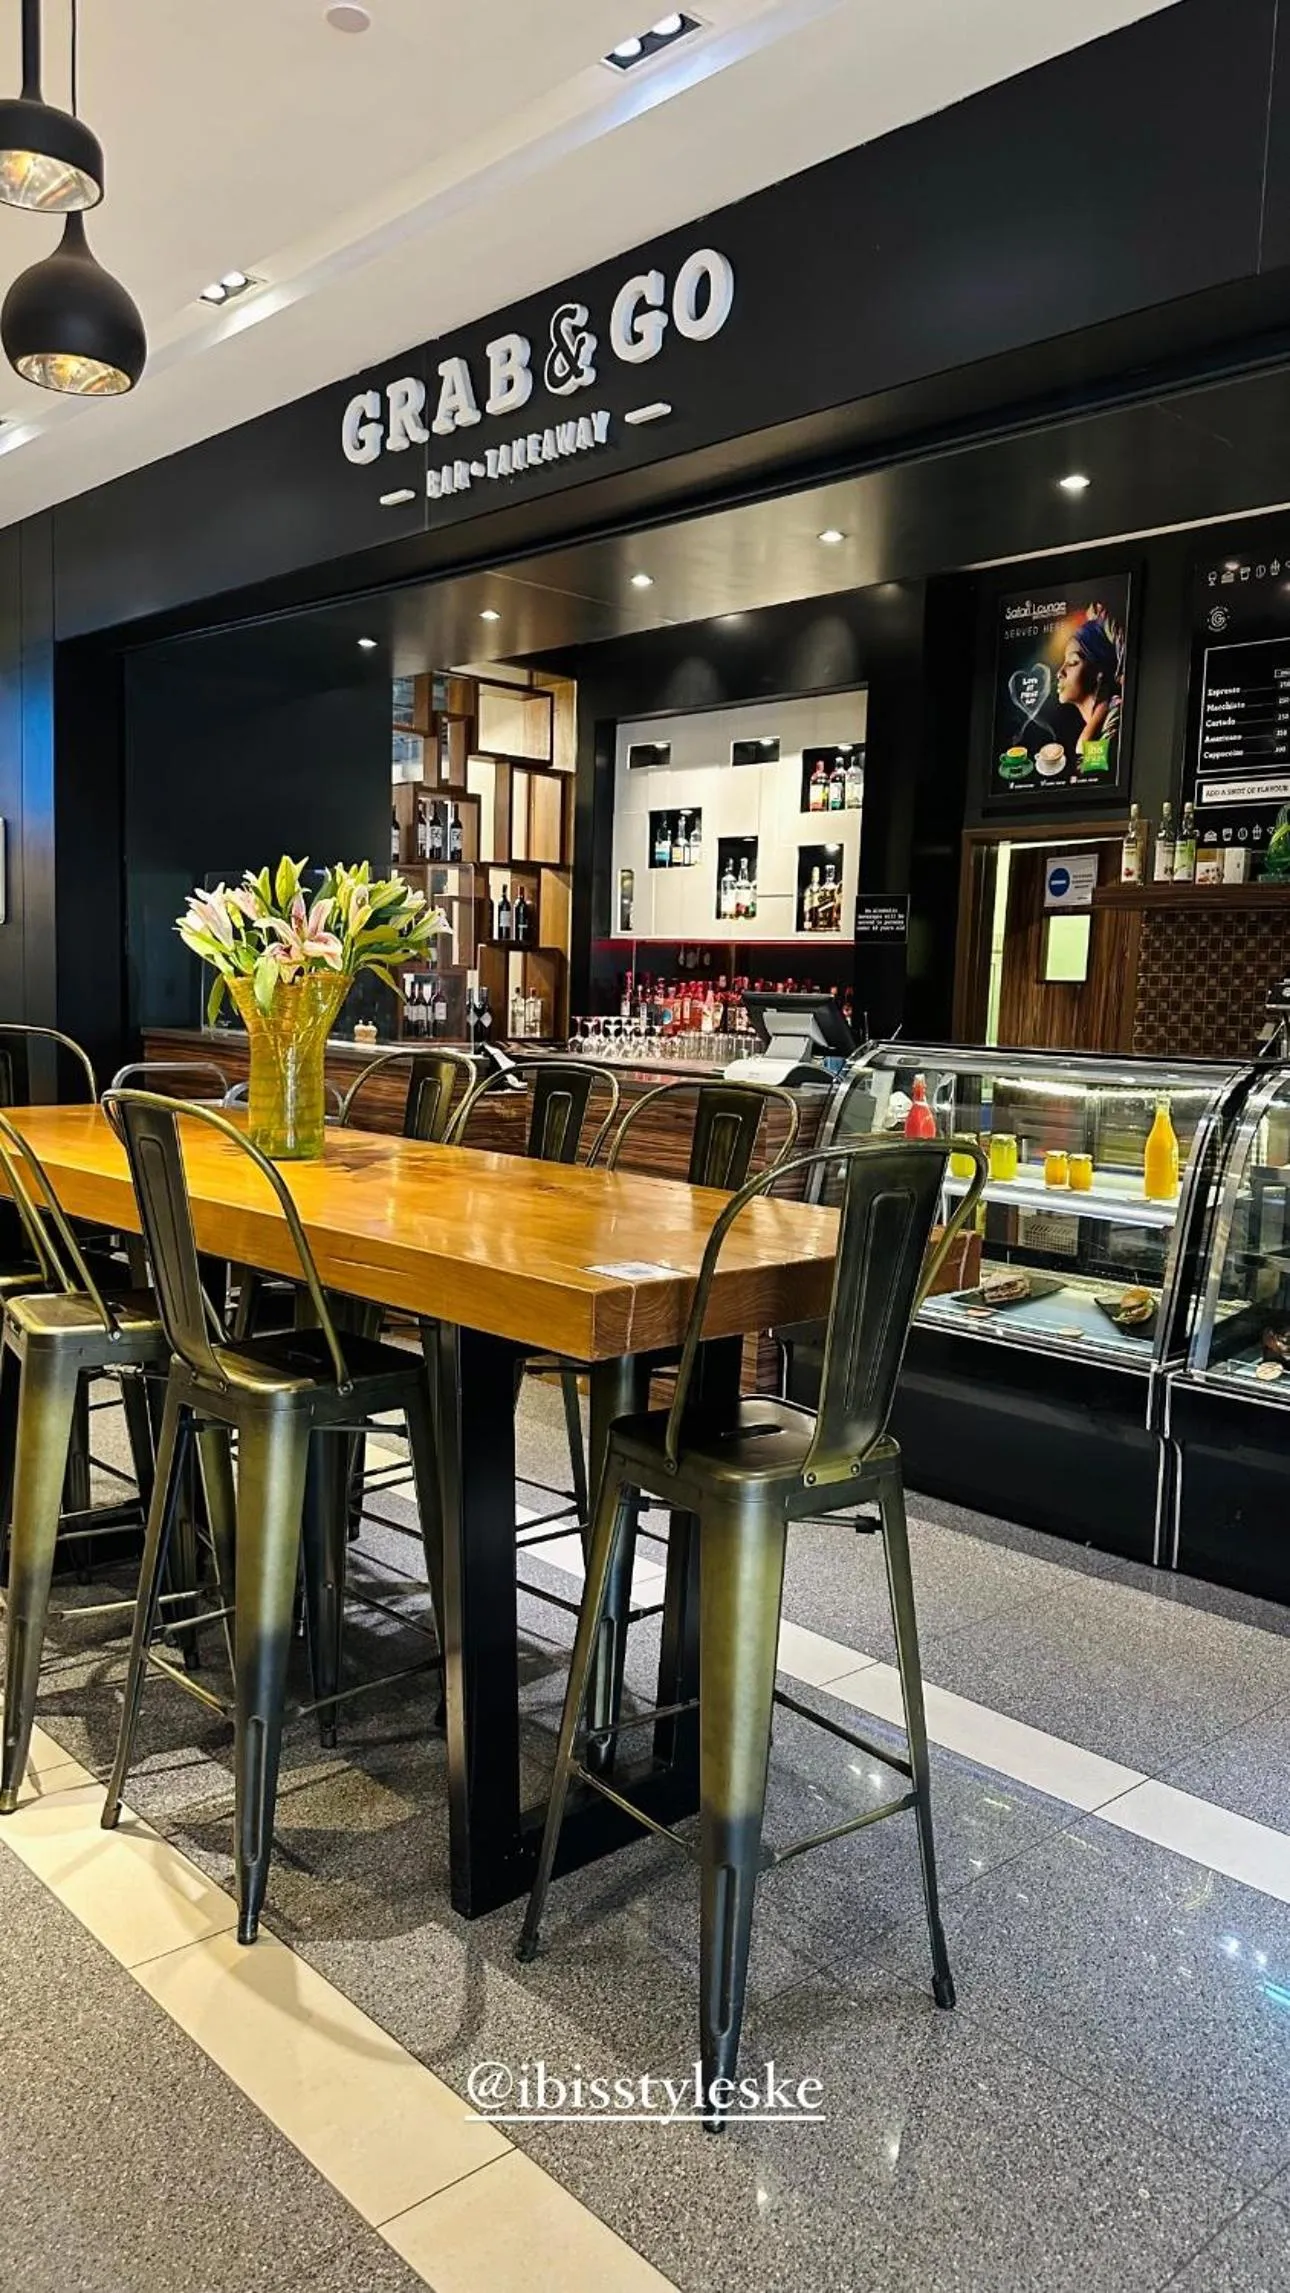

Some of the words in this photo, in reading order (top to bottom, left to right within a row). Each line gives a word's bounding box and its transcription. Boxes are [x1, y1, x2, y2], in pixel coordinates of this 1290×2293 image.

[342, 333, 533, 465] GRAB
[544, 303, 598, 396] &
[610, 248, 734, 364] GO
[1004, 626, 1039, 640] SERVED
[1207, 687, 1241, 697] Espresso
[1206, 701, 1245, 712] Macchiato
[1205, 716, 1236, 728] Cortado
[1204, 735, 1243, 743] Americano
[1203, 749, 1244, 760] Cappuccino
